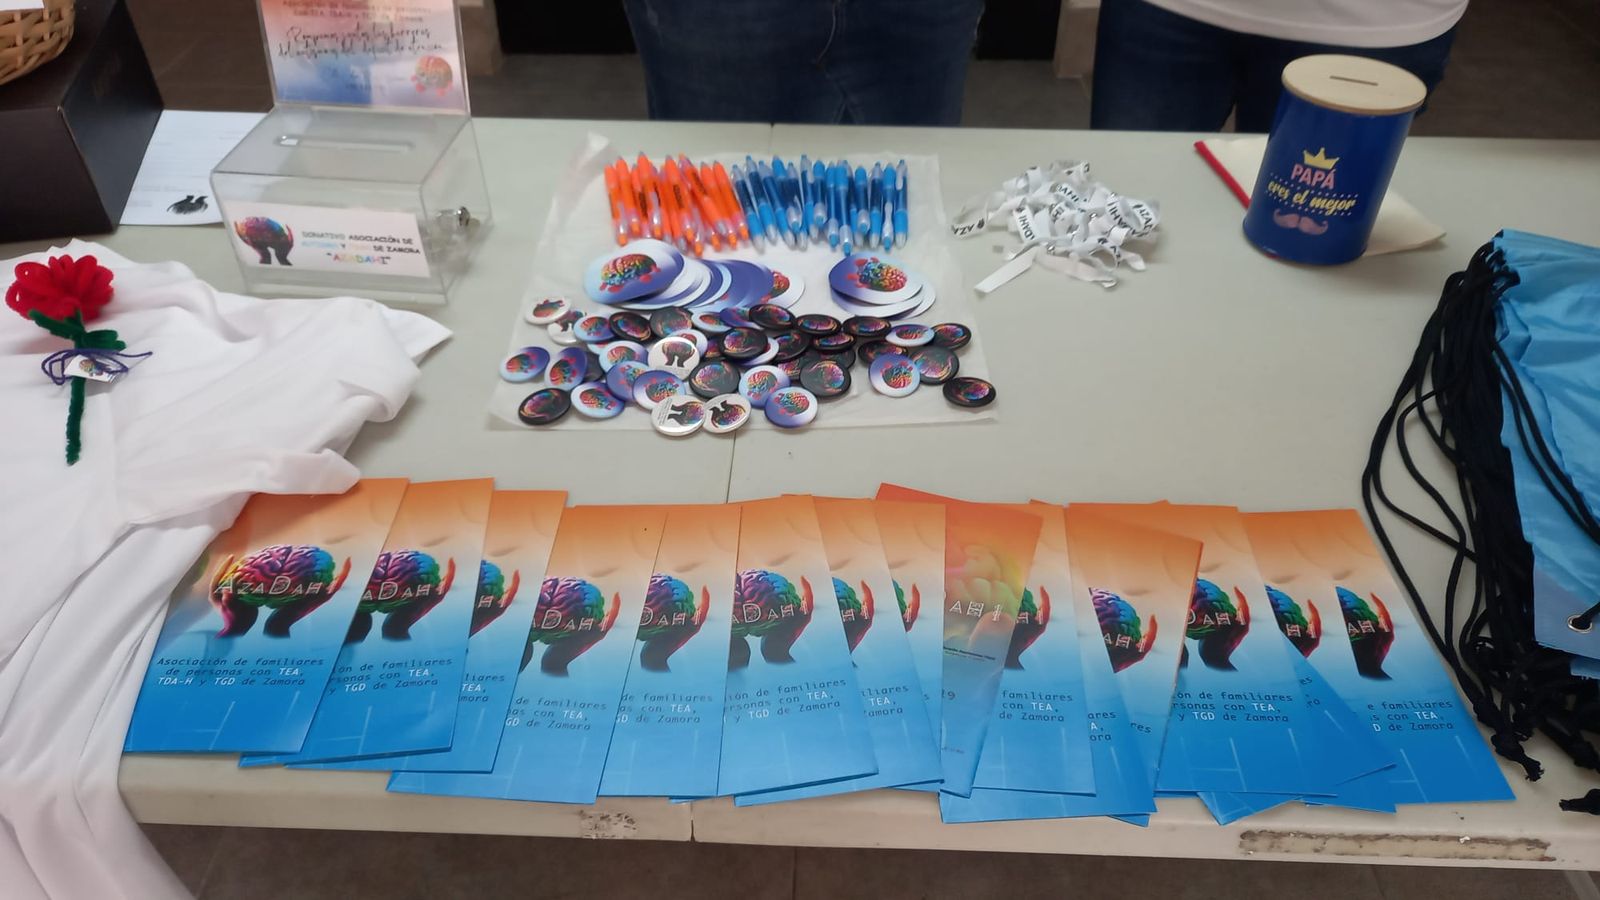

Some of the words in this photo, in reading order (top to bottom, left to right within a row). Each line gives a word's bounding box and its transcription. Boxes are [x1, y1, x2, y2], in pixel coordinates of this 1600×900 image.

[1291, 163, 1336, 189] PAPÁ
[1268, 181, 1290, 196] eres
[1293, 188, 1309, 204] el
[1310, 195, 1356, 216] mejor
[387, 246, 421, 255] ZAMORA
[157, 657, 227, 666] Asociación
[234, 657, 248, 666] de
[255, 657, 324, 666] familiares
[360, 662, 374, 671] de
[382, 657, 453, 670] familiares
[165, 667, 180, 676] de
[185, 668, 242, 678] personas
[250, 668, 271, 676] con
[379, 671, 400, 681] con
[157, 677, 193, 686] TDA-H
[199, 679, 206, 687] y
[214, 677, 235, 686] TGD
[241, 677, 255, 686] de
[263, 677, 305, 686] Zamora
[345, 683, 366, 692] TGD
[373, 681, 386, 690] de
[395, 679, 438, 689] Zamora
[756, 688, 769, 697] de
[778, 679, 847, 694] familiares
[643, 692, 714, 703] familiares
[779, 695, 799, 704] con
[1002, 690, 1074, 702] familiares
[1199, 691, 1213, 700] de
[1221, 691, 1293, 702] familiares
[516, 697, 529, 705] de
[536, 697, 607, 710] familiares
[1002, 702, 1024, 710] con
[1223, 703, 1246, 711] con
[1381, 700, 1454, 711] familiares
[534, 709, 554, 718] con
[735, 715, 742, 724] y
[749, 709, 770, 719] TGD
[777, 706, 789, 716] de
[799, 700, 840, 713] Zamora
[999, 711, 1013, 720] de
[1021, 712, 1065, 723] Zamora
[1177, 713, 1185, 721] y
[1192, 711, 1215, 720] TGD
[1223, 712, 1237, 721] de
[1246, 712, 1289, 722] Zamora
[1387, 713, 1409, 721] con
[635, 714, 649, 723] de
[657, 714, 701, 724] Zamora
[526, 719, 540, 728] de
[549, 720, 591, 731] Zamora
[1388, 723, 1402, 732] de
[1409, 722, 1454, 731] Zamora
